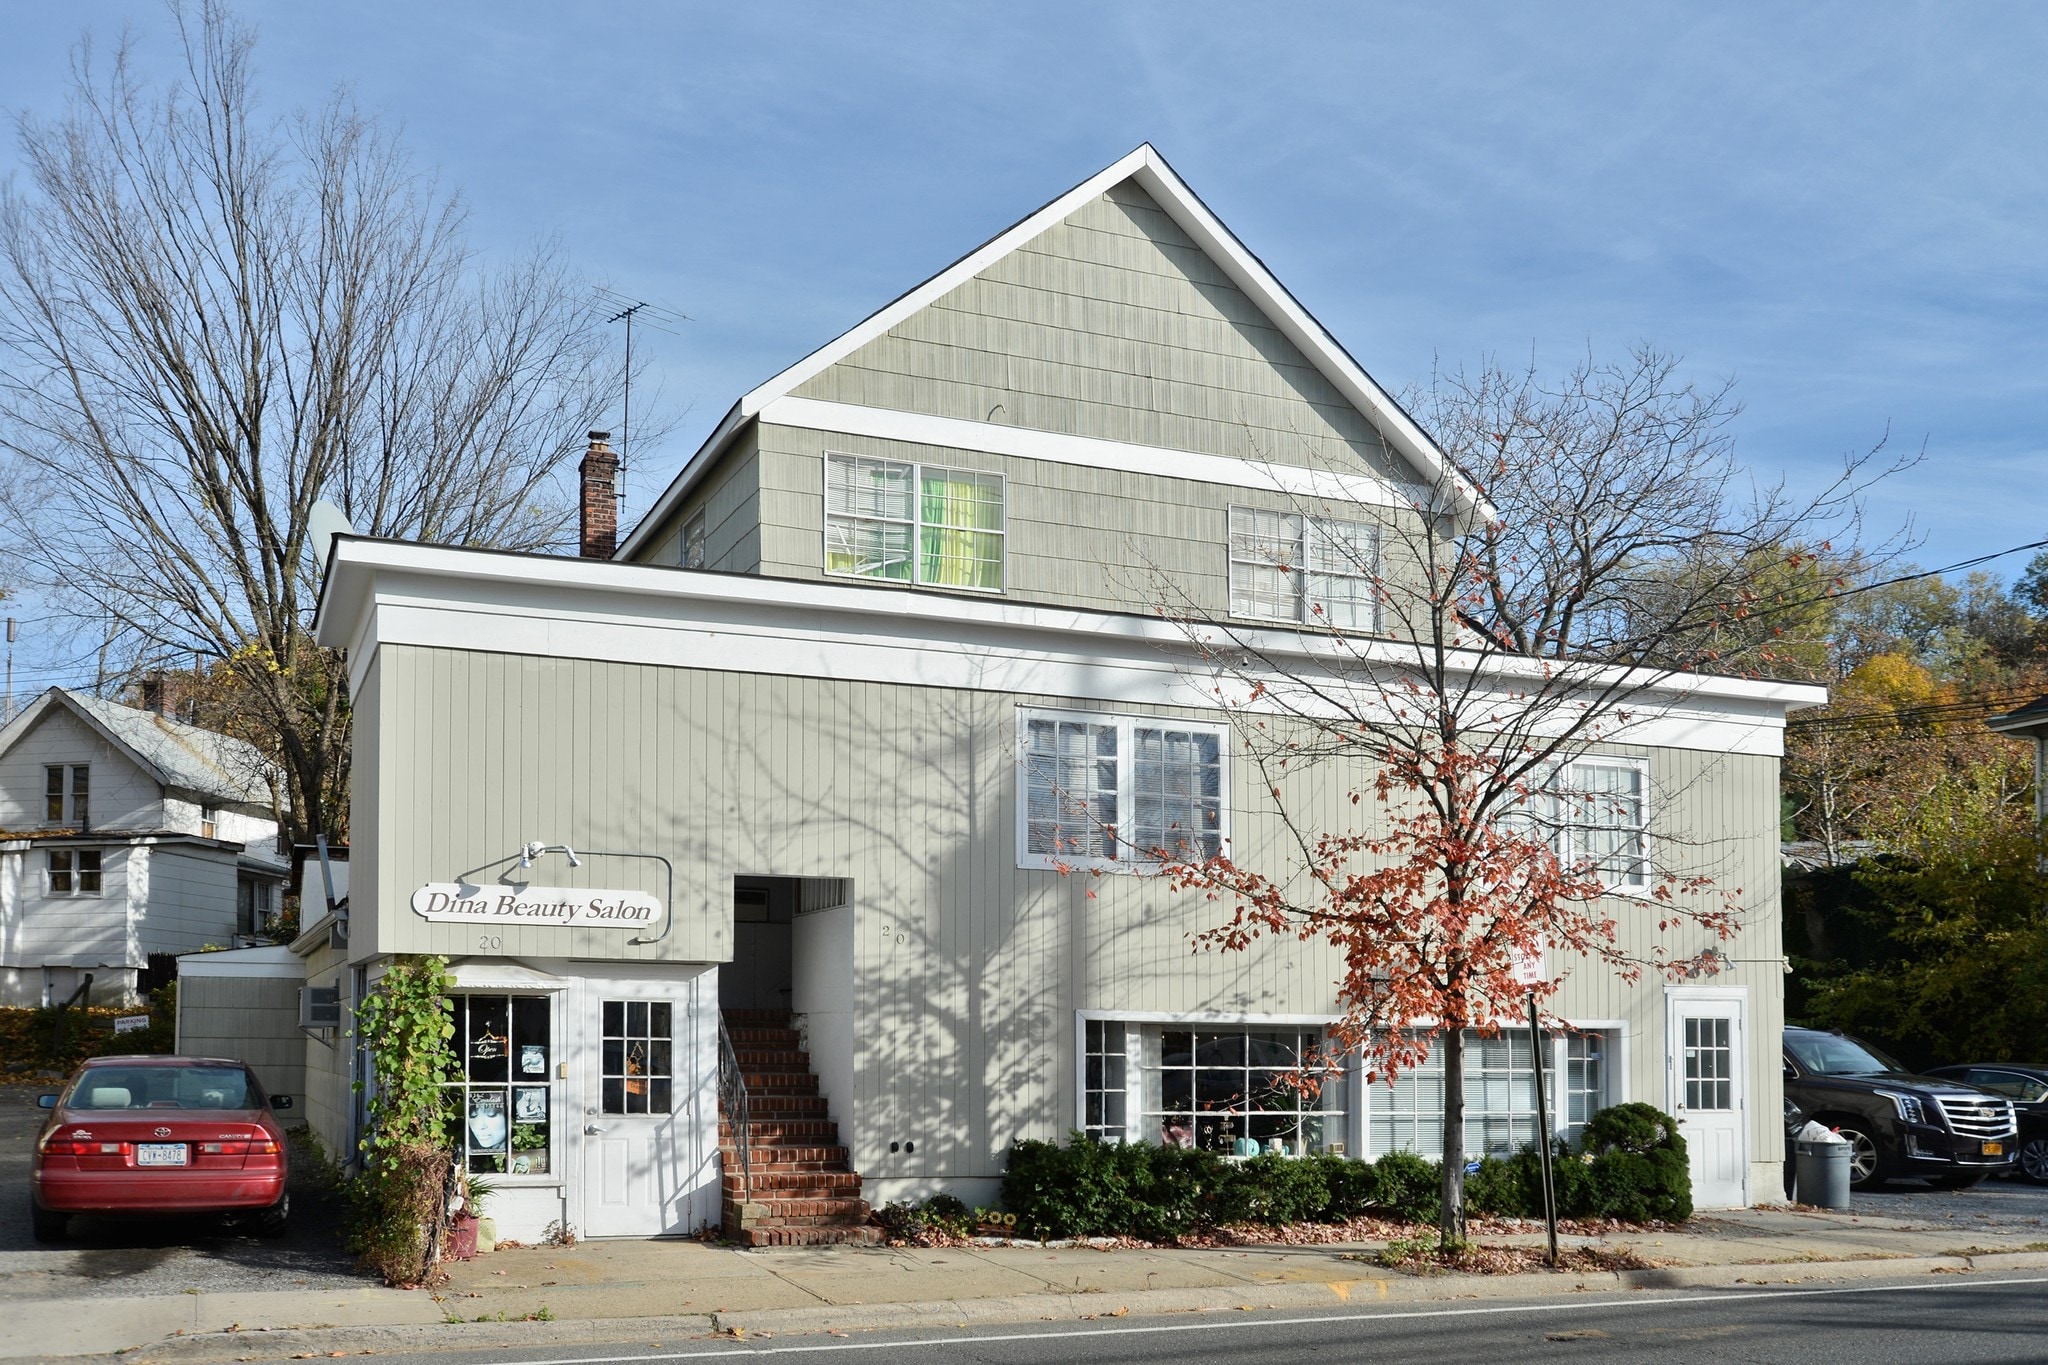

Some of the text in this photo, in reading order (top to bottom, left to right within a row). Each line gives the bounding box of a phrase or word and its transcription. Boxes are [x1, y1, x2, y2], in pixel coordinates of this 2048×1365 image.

[425, 891, 651, 924] Dina Beauty Salon
[479, 935, 501, 950] 20
[1523, 961, 1536, 970] ANY
[1523, 971, 1537, 980] TIME
[117, 1017, 147, 1025] PARKING
[477, 1044, 498, 1056] Open
